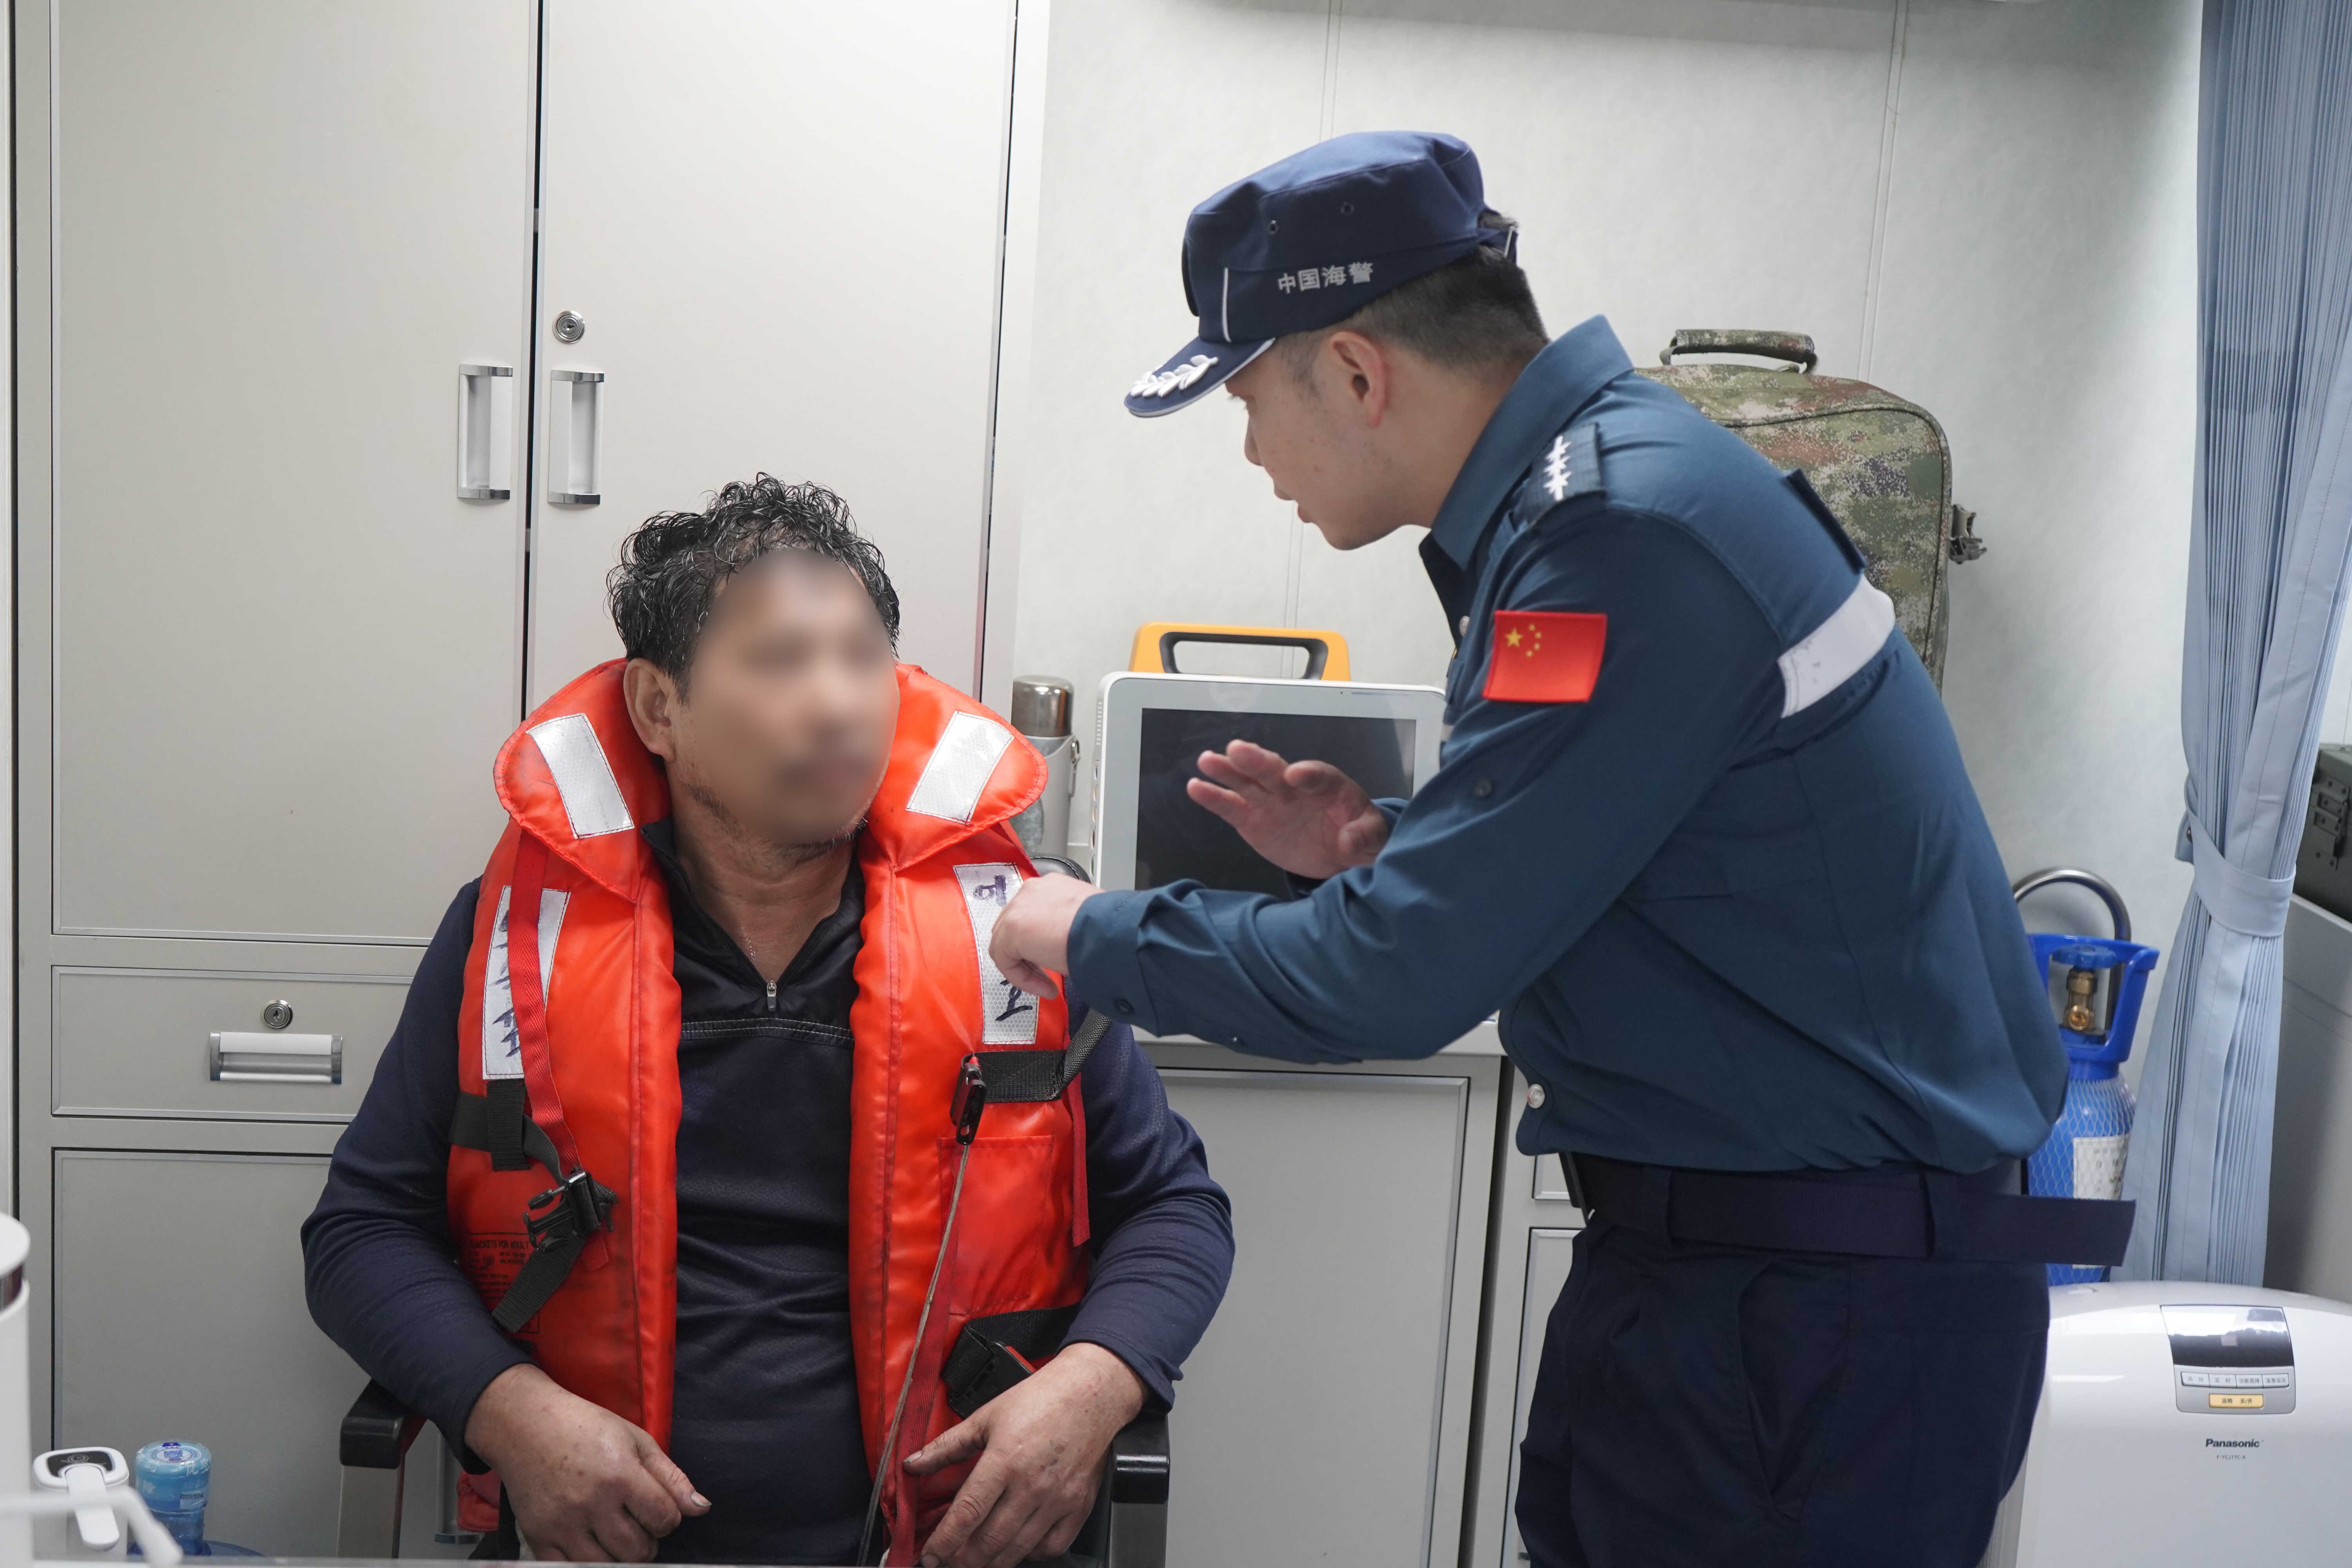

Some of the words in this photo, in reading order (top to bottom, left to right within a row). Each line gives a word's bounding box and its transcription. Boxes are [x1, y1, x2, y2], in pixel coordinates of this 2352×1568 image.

[1278, 261, 1373, 294] 中国海警
[2205, 1438, 2260, 1447] Panasonic
